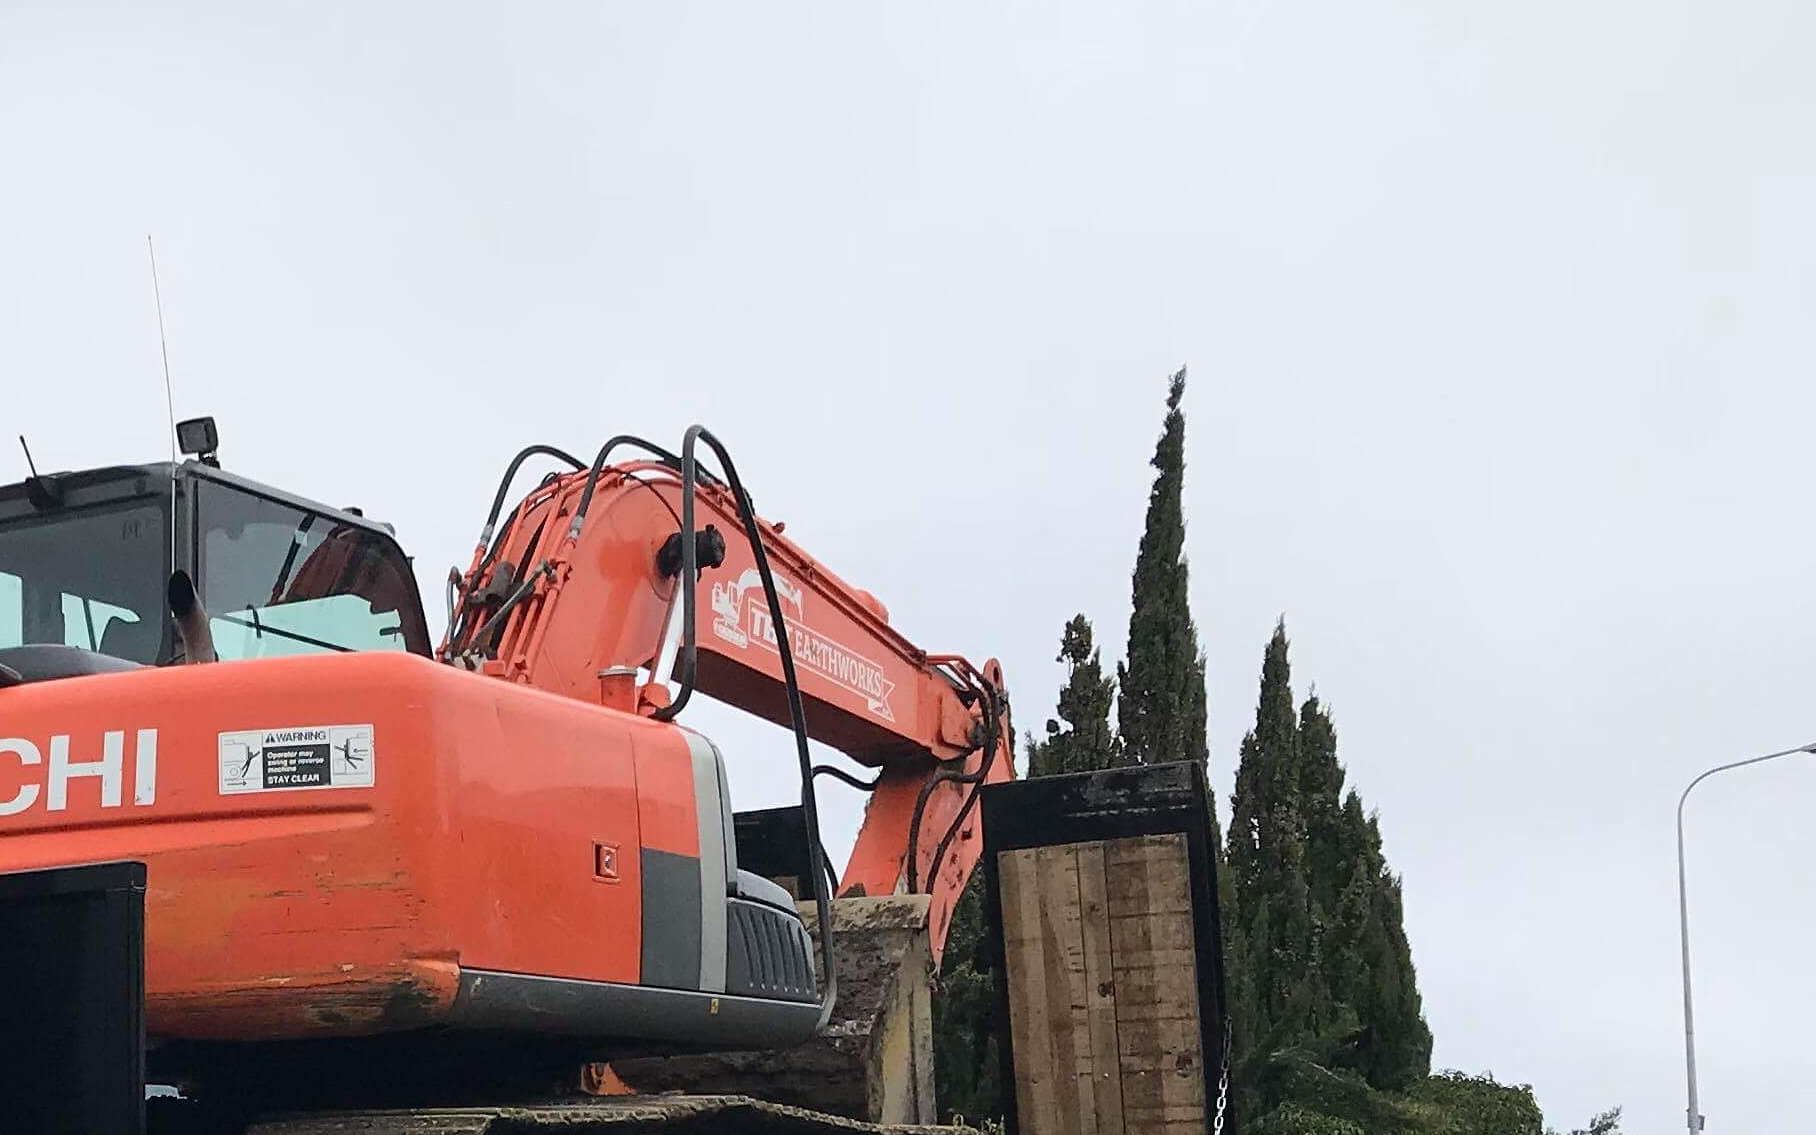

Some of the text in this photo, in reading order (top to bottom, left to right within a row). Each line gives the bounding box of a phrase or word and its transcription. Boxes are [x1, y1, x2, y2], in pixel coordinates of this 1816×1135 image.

[795, 629, 882, 698] EARTHWORKS
[276, 731, 326, 743] WARNING
[267, 751, 298, 760] Operator
[268, 773, 320, 784] STAY CLEAR
